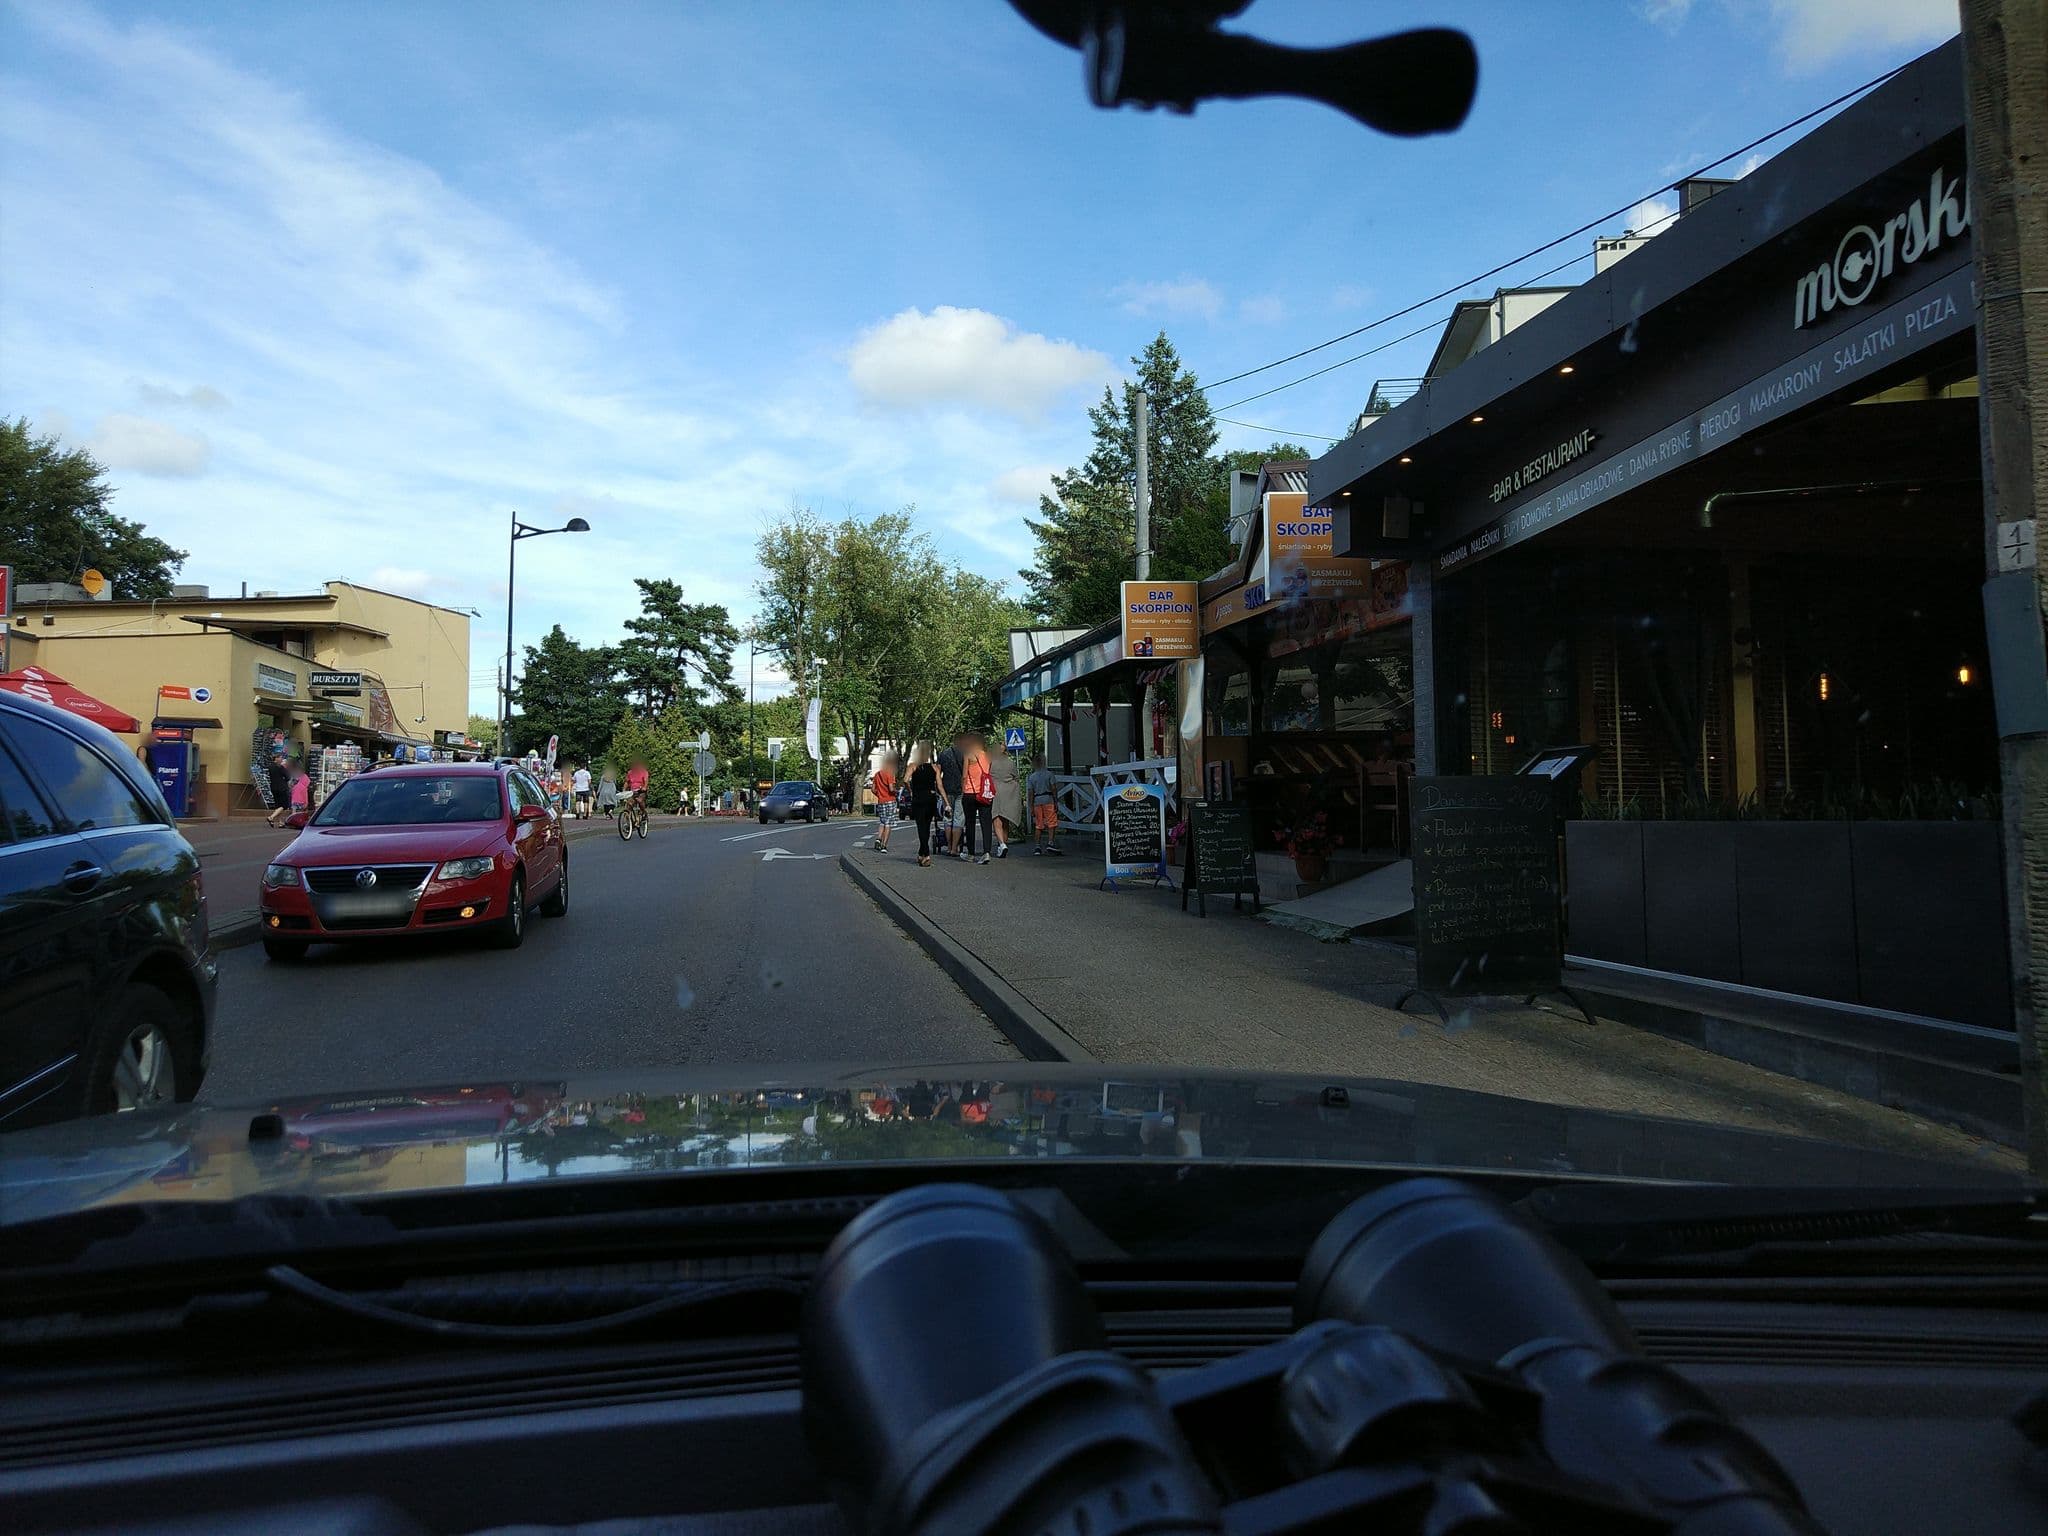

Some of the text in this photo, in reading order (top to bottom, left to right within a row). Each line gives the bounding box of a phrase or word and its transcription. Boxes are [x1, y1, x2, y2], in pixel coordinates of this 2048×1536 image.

[1470, 528, 1500, 555] NALEŚNIKI
[1521, 501, 1554, 530] DOMOWE
[1557, 487, 1578, 513] DANIA
[1579, 464, 1624, 502] OBIADOWE
[1629, 449, 1657, 477] DANIA
[1659, 428, 1692, 464] RYBNE
[1699, 404, 1742, 447] PIEROGI
[1749, 360, 1823, 421] MAKARONY
[1833, 323, 1896, 378] SAŁATKI
[1905, 294, 1959, 343] PIZZA
[1514, 467, 1521, 491] &
[1277, 523, 1332, 535] SKORP
[1149, 591, 1174, 600] BAR
[1130, 603, 1193, 613] SKORPION
[312, 675, 360, 684] BURSZTYN
